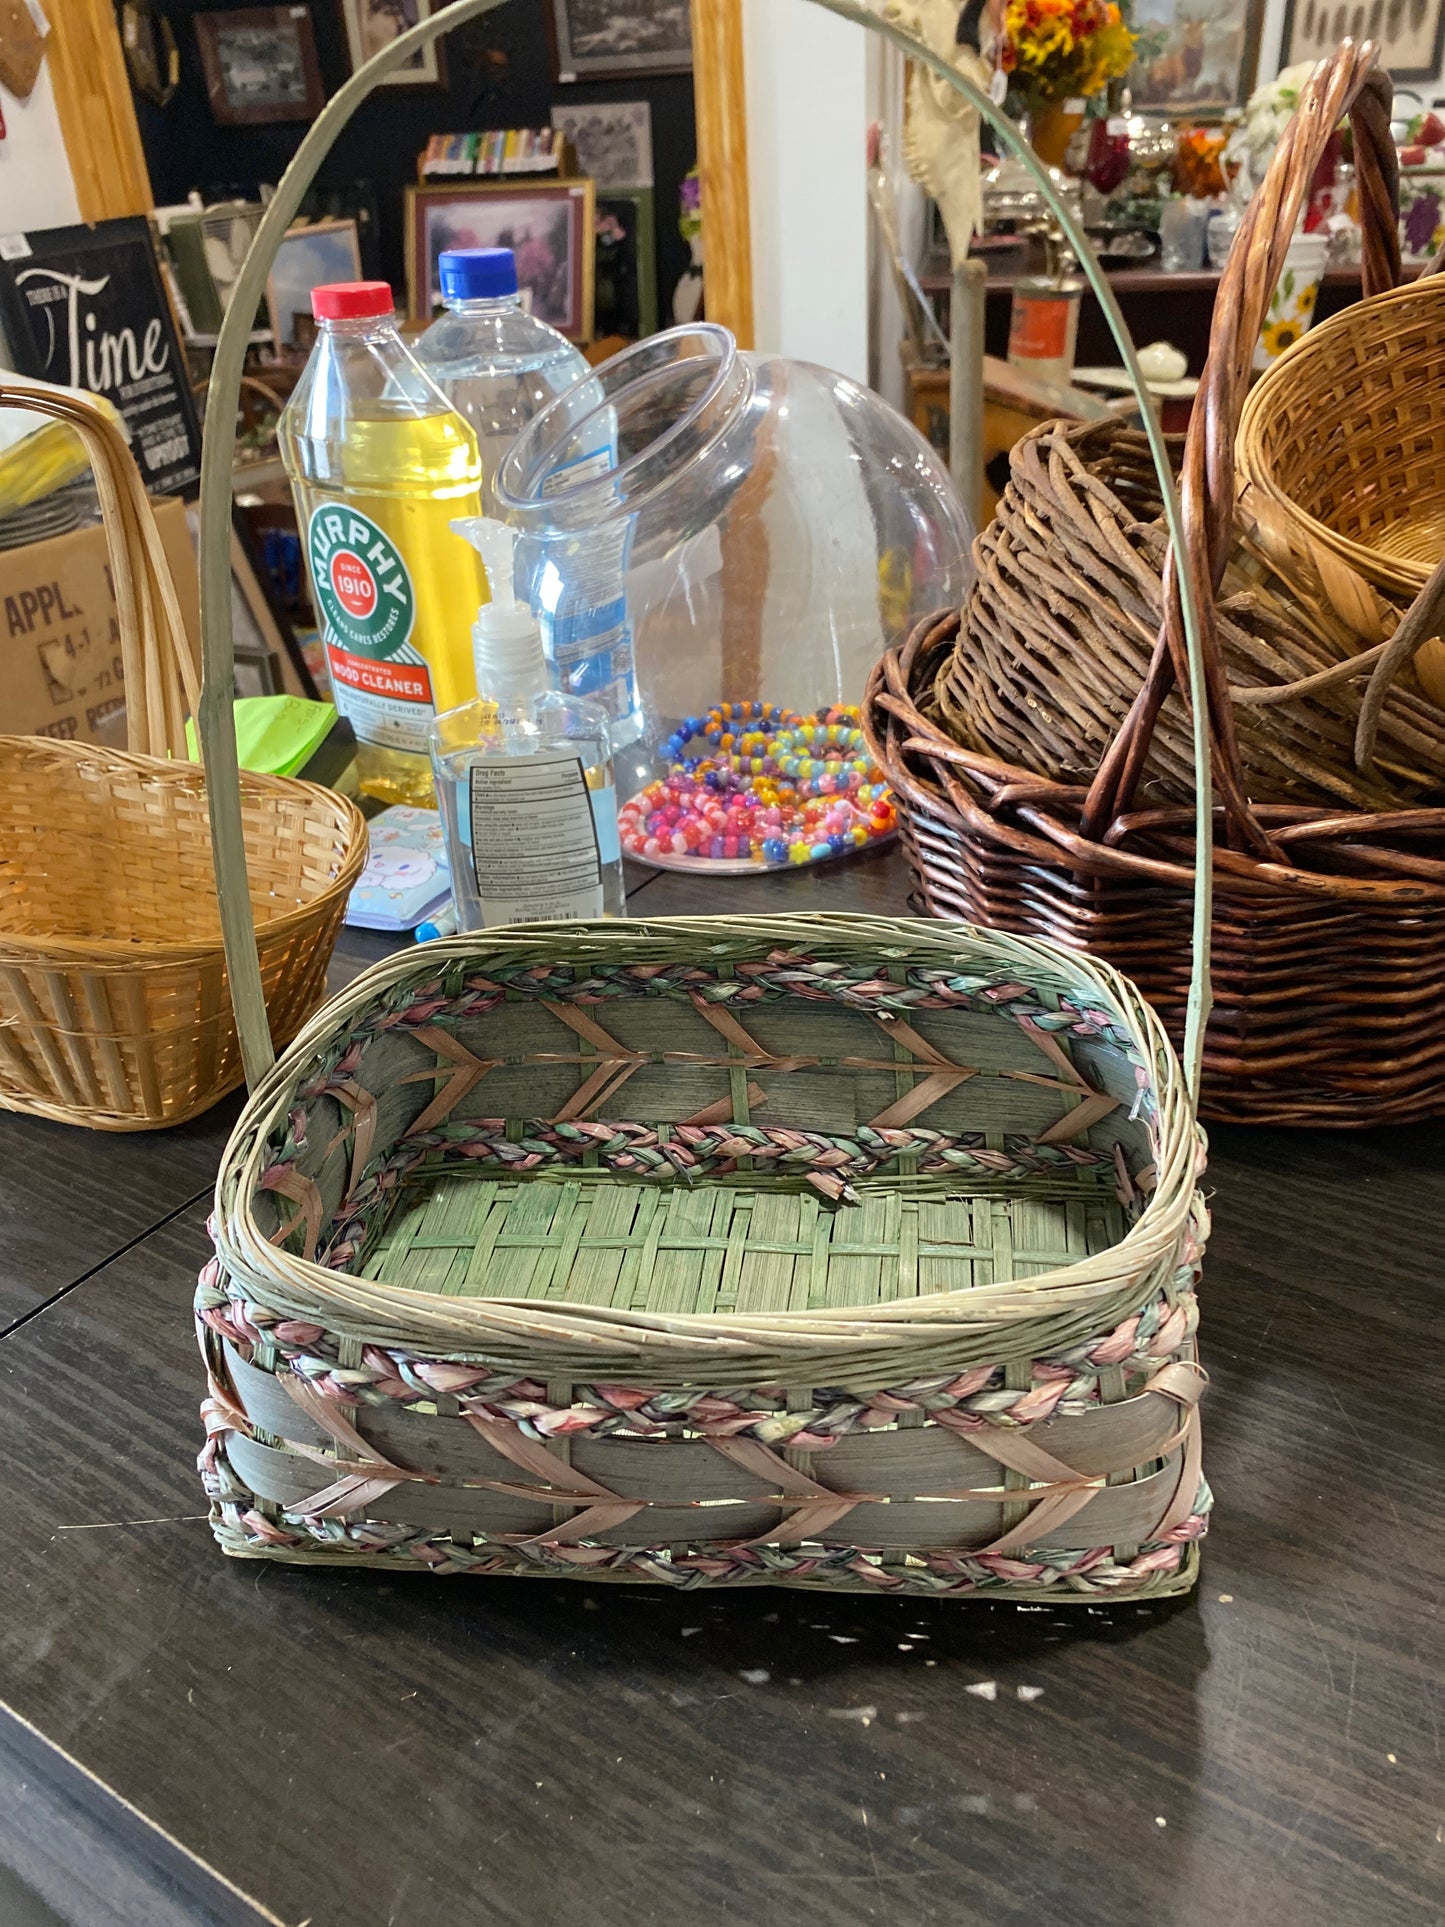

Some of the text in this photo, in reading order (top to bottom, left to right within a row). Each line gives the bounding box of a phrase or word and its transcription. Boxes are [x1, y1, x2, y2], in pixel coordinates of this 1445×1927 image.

[15, 268, 169, 392] Time
[313, 514, 407, 605] MURPHY
[340, 563, 361, 575] SINCE
[338, 575, 372, 598] 1910
[362, 672, 424, 697] CLEANER
[475, 769, 506, 778] Drug Facts
